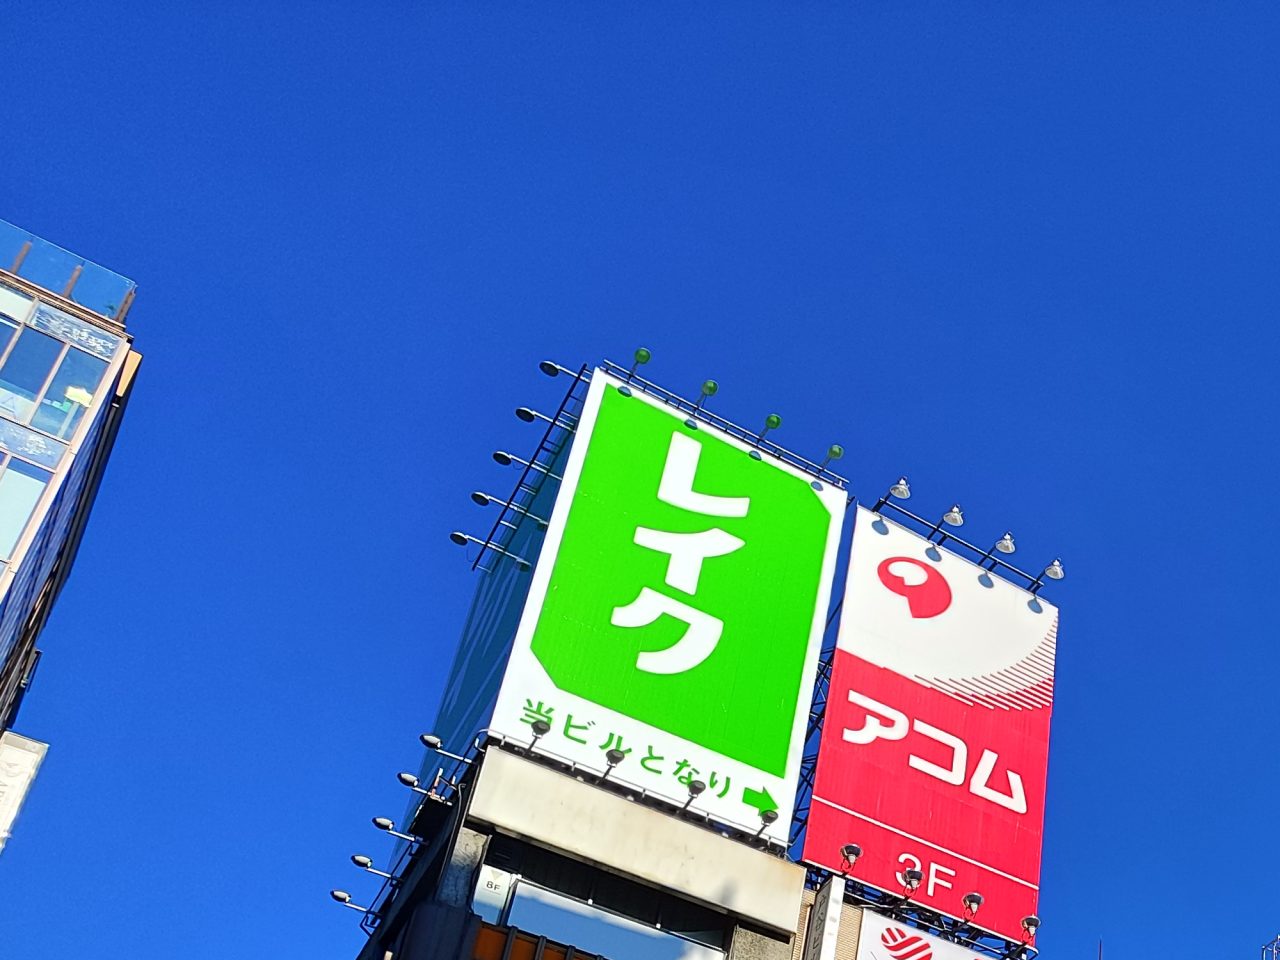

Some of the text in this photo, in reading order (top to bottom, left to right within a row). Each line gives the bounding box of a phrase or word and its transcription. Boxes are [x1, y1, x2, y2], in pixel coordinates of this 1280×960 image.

[610, 430, 751, 676] レイク
[519, 698, 733, 799] 当ビルとなり
[842, 689, 1029, 815] アコム
[896, 853, 957, 900] 3F
